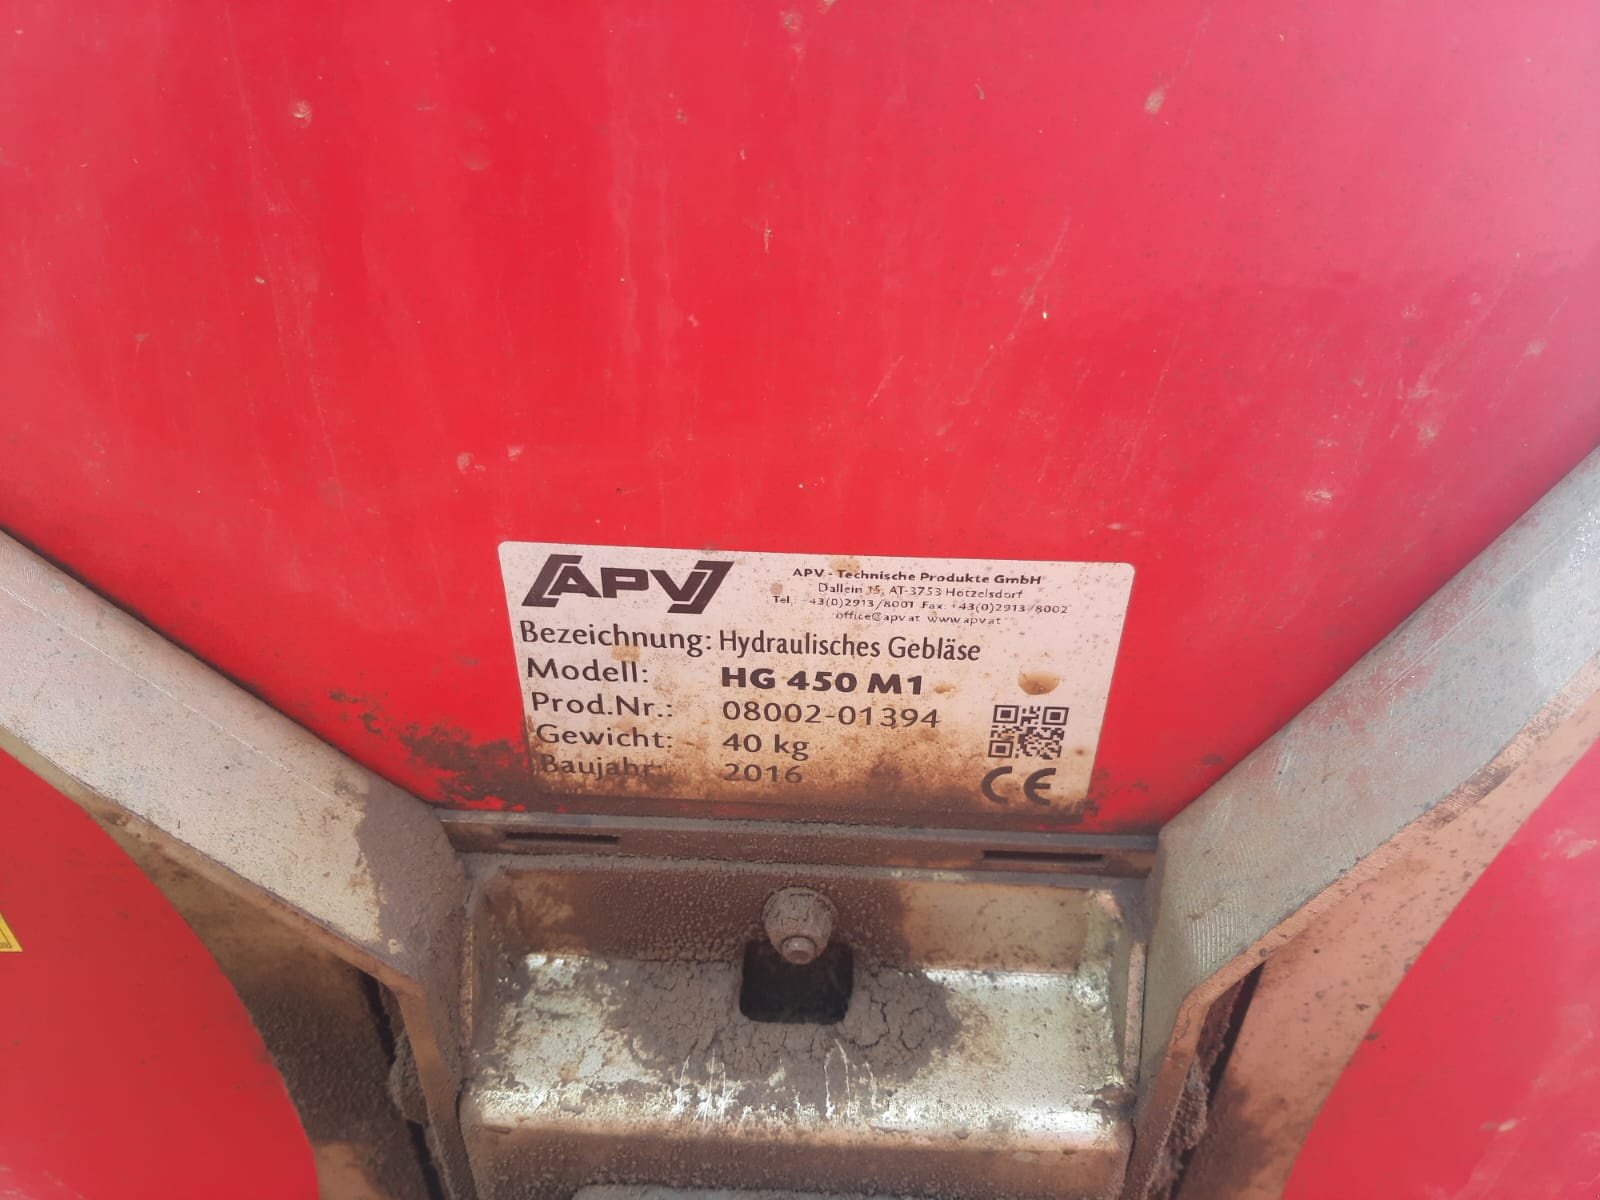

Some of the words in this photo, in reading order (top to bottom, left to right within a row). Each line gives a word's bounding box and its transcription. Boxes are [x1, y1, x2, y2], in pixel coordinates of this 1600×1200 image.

[521, 553, 735, 615] APV
[792, 568, 825, 577] APV
[837, 569, 916, 581] Technische
[920, 572, 990, 583] Produkte
[994, 574, 1042, 585] GmbH
[818, 582, 863, 594] Dallein
[889, 585, 942, 597] AT-3753
[835, 611, 920, 624] office@apvat
[927, 615, 1001, 626] wwwapvat
[520, 620, 711, 657] Bezeichnung:
[720, 630, 880, 658] Hydraulisches
[888, 636, 981, 661] Gebläse
[527, 657, 648, 683] Modell:
[721, 667, 776, 689] HG
[786, 671, 858, 693] 450
[867, 673, 922, 695] M1
[532, 692, 673, 717] Prod.Nr.:
[722, 701, 940, 728] 08002-01394
[536, 723, 673, 749] Gewicht:
[722, 733, 762, 753] 40
[774, 734, 810, 761] kg
[723, 763, 803, 784] 2016
